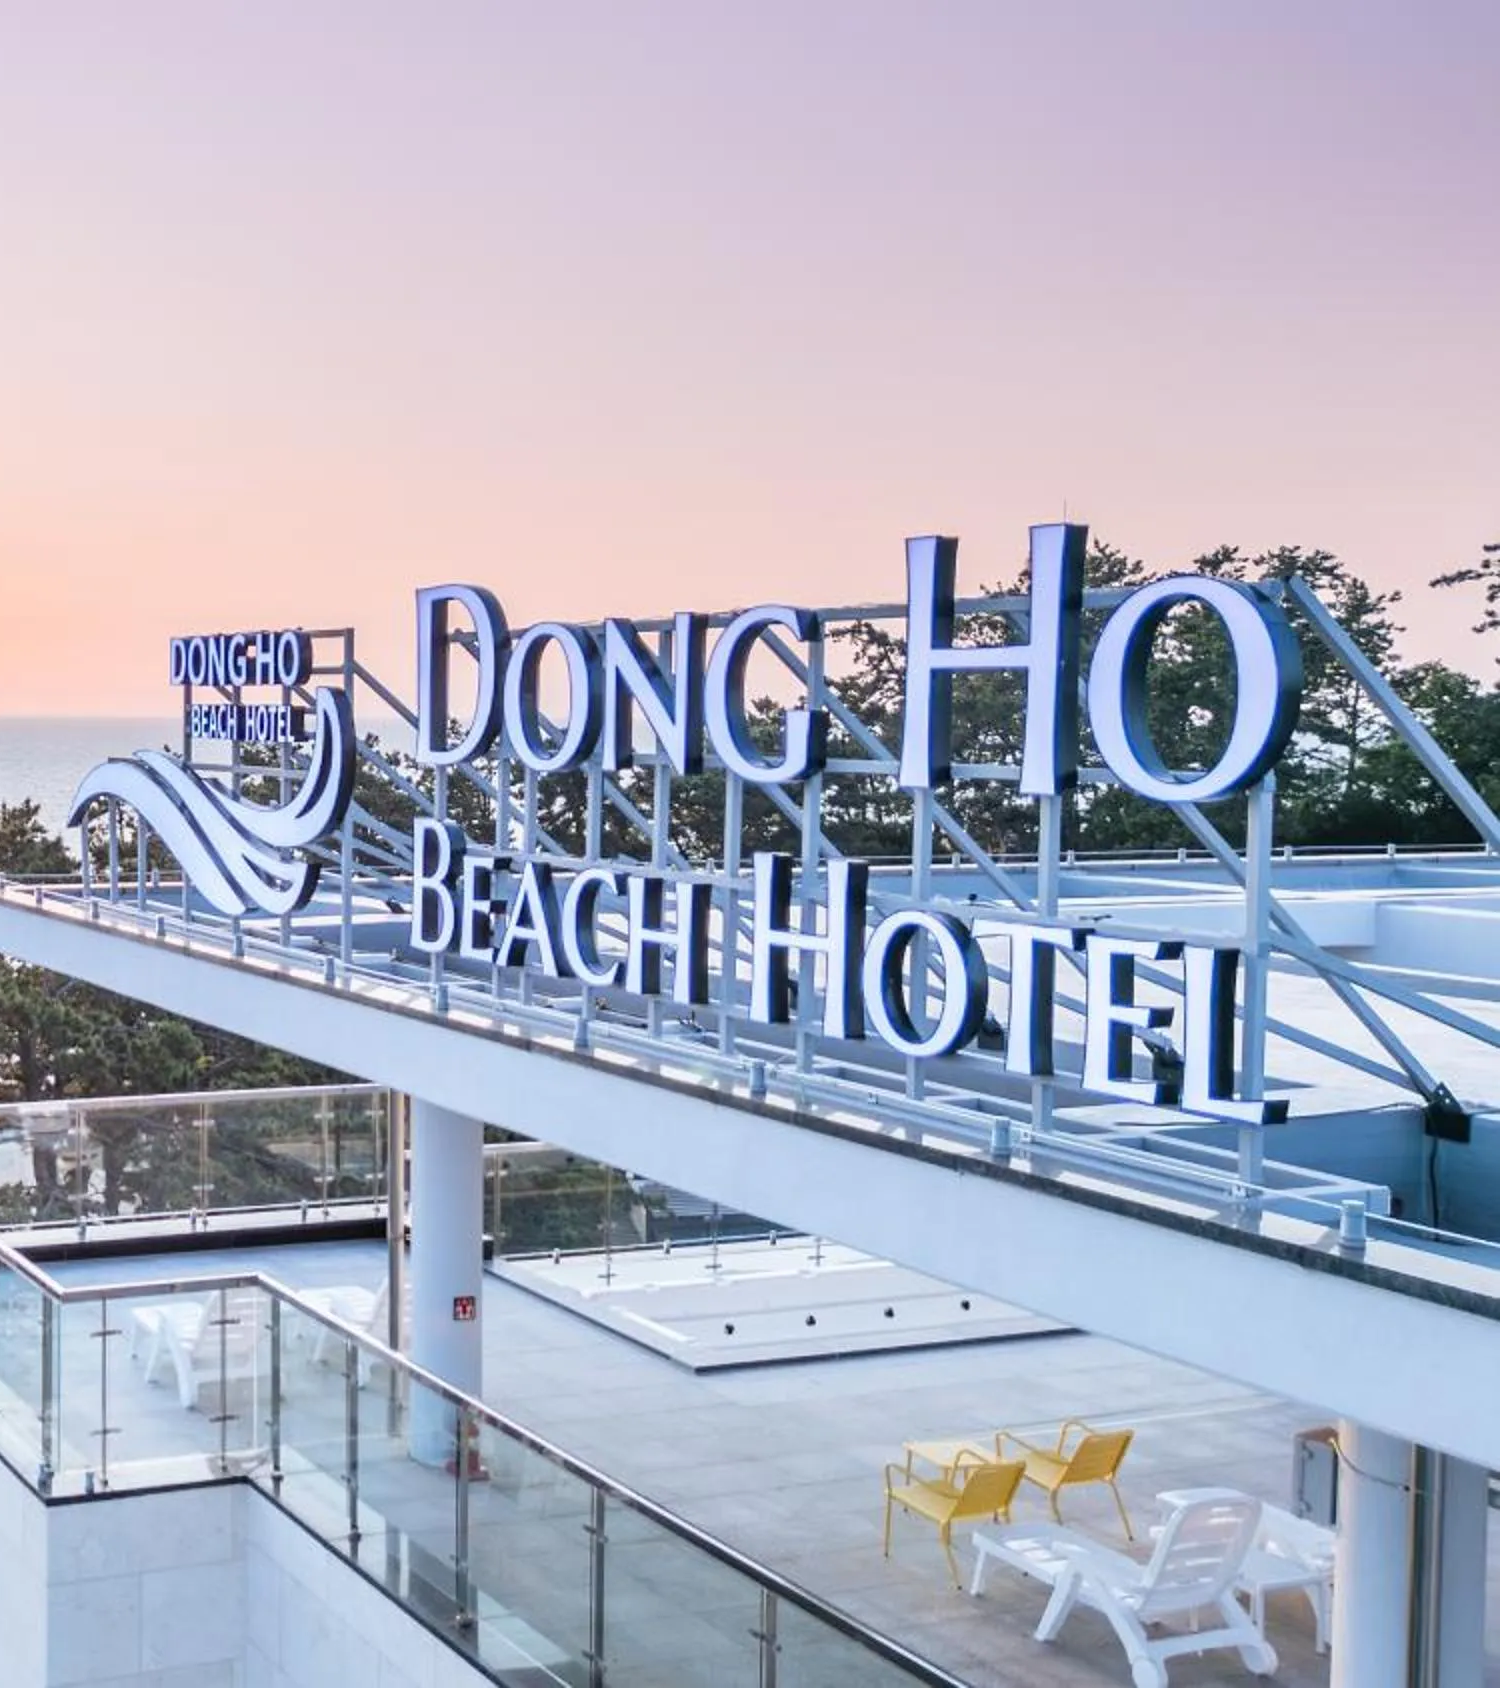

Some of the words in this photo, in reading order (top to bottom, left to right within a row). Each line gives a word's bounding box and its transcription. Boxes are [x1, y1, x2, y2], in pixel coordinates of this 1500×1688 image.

[170, 634, 247, 687] DONG
[255, 631, 304, 687] HO
[191, 704, 238, 740] BEACH
[245, 704, 295, 743] HOTEL
[415, 583, 822, 784] DONG
[900, 524, 1292, 801] HO
[410, 817, 710, 1004] BEACH
[749, 852, 1284, 1125] HOTEL
